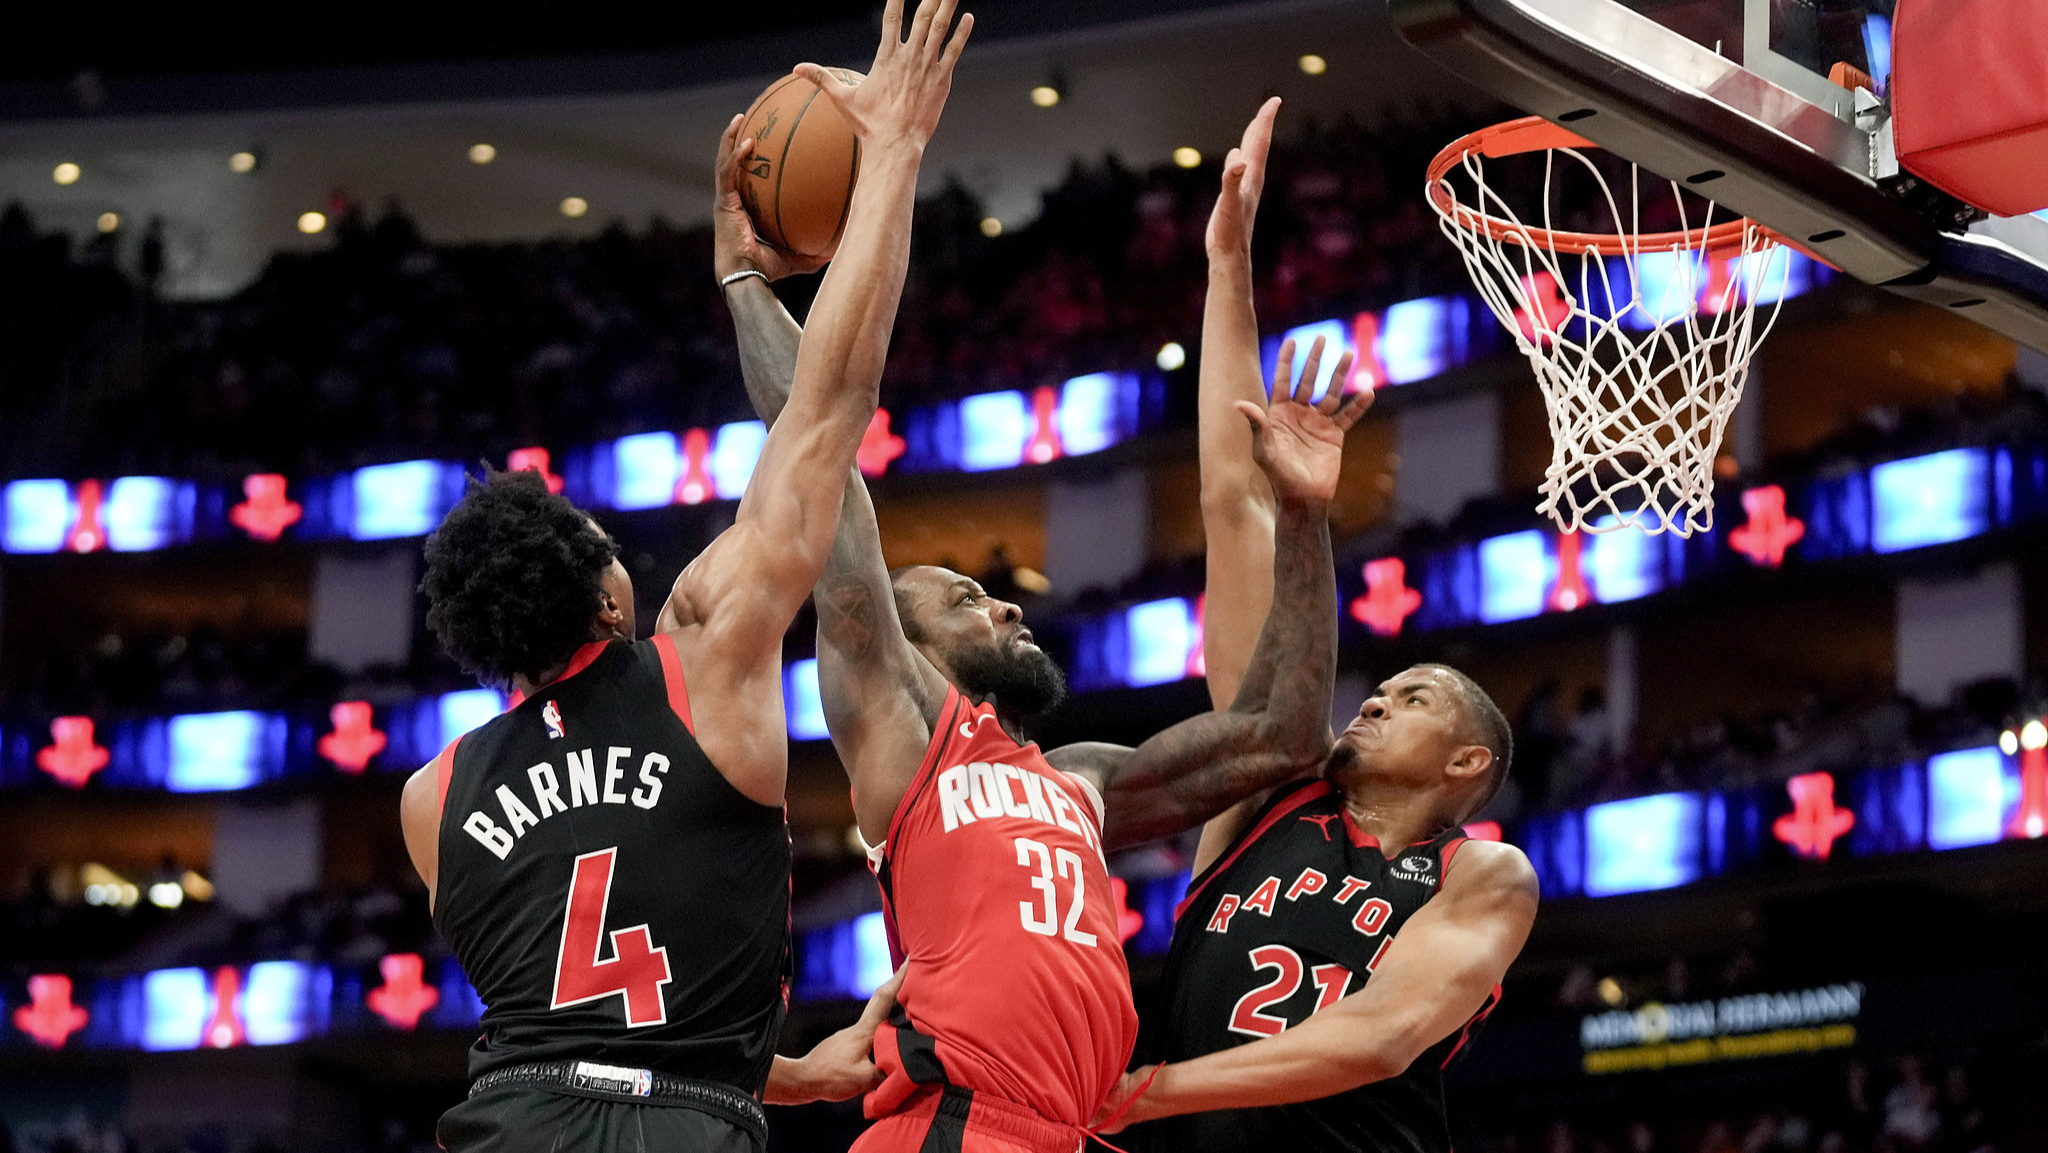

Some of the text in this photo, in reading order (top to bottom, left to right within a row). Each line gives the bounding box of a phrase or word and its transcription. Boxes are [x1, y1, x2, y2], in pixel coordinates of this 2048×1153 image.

[463, 746, 671, 860] BARNES
[1014, 837, 1097, 947] 32
[1390, 867, 1436, 886] Sun Life
[550, 846, 672, 1028] 4
[1228, 944, 1353, 1037] 21
